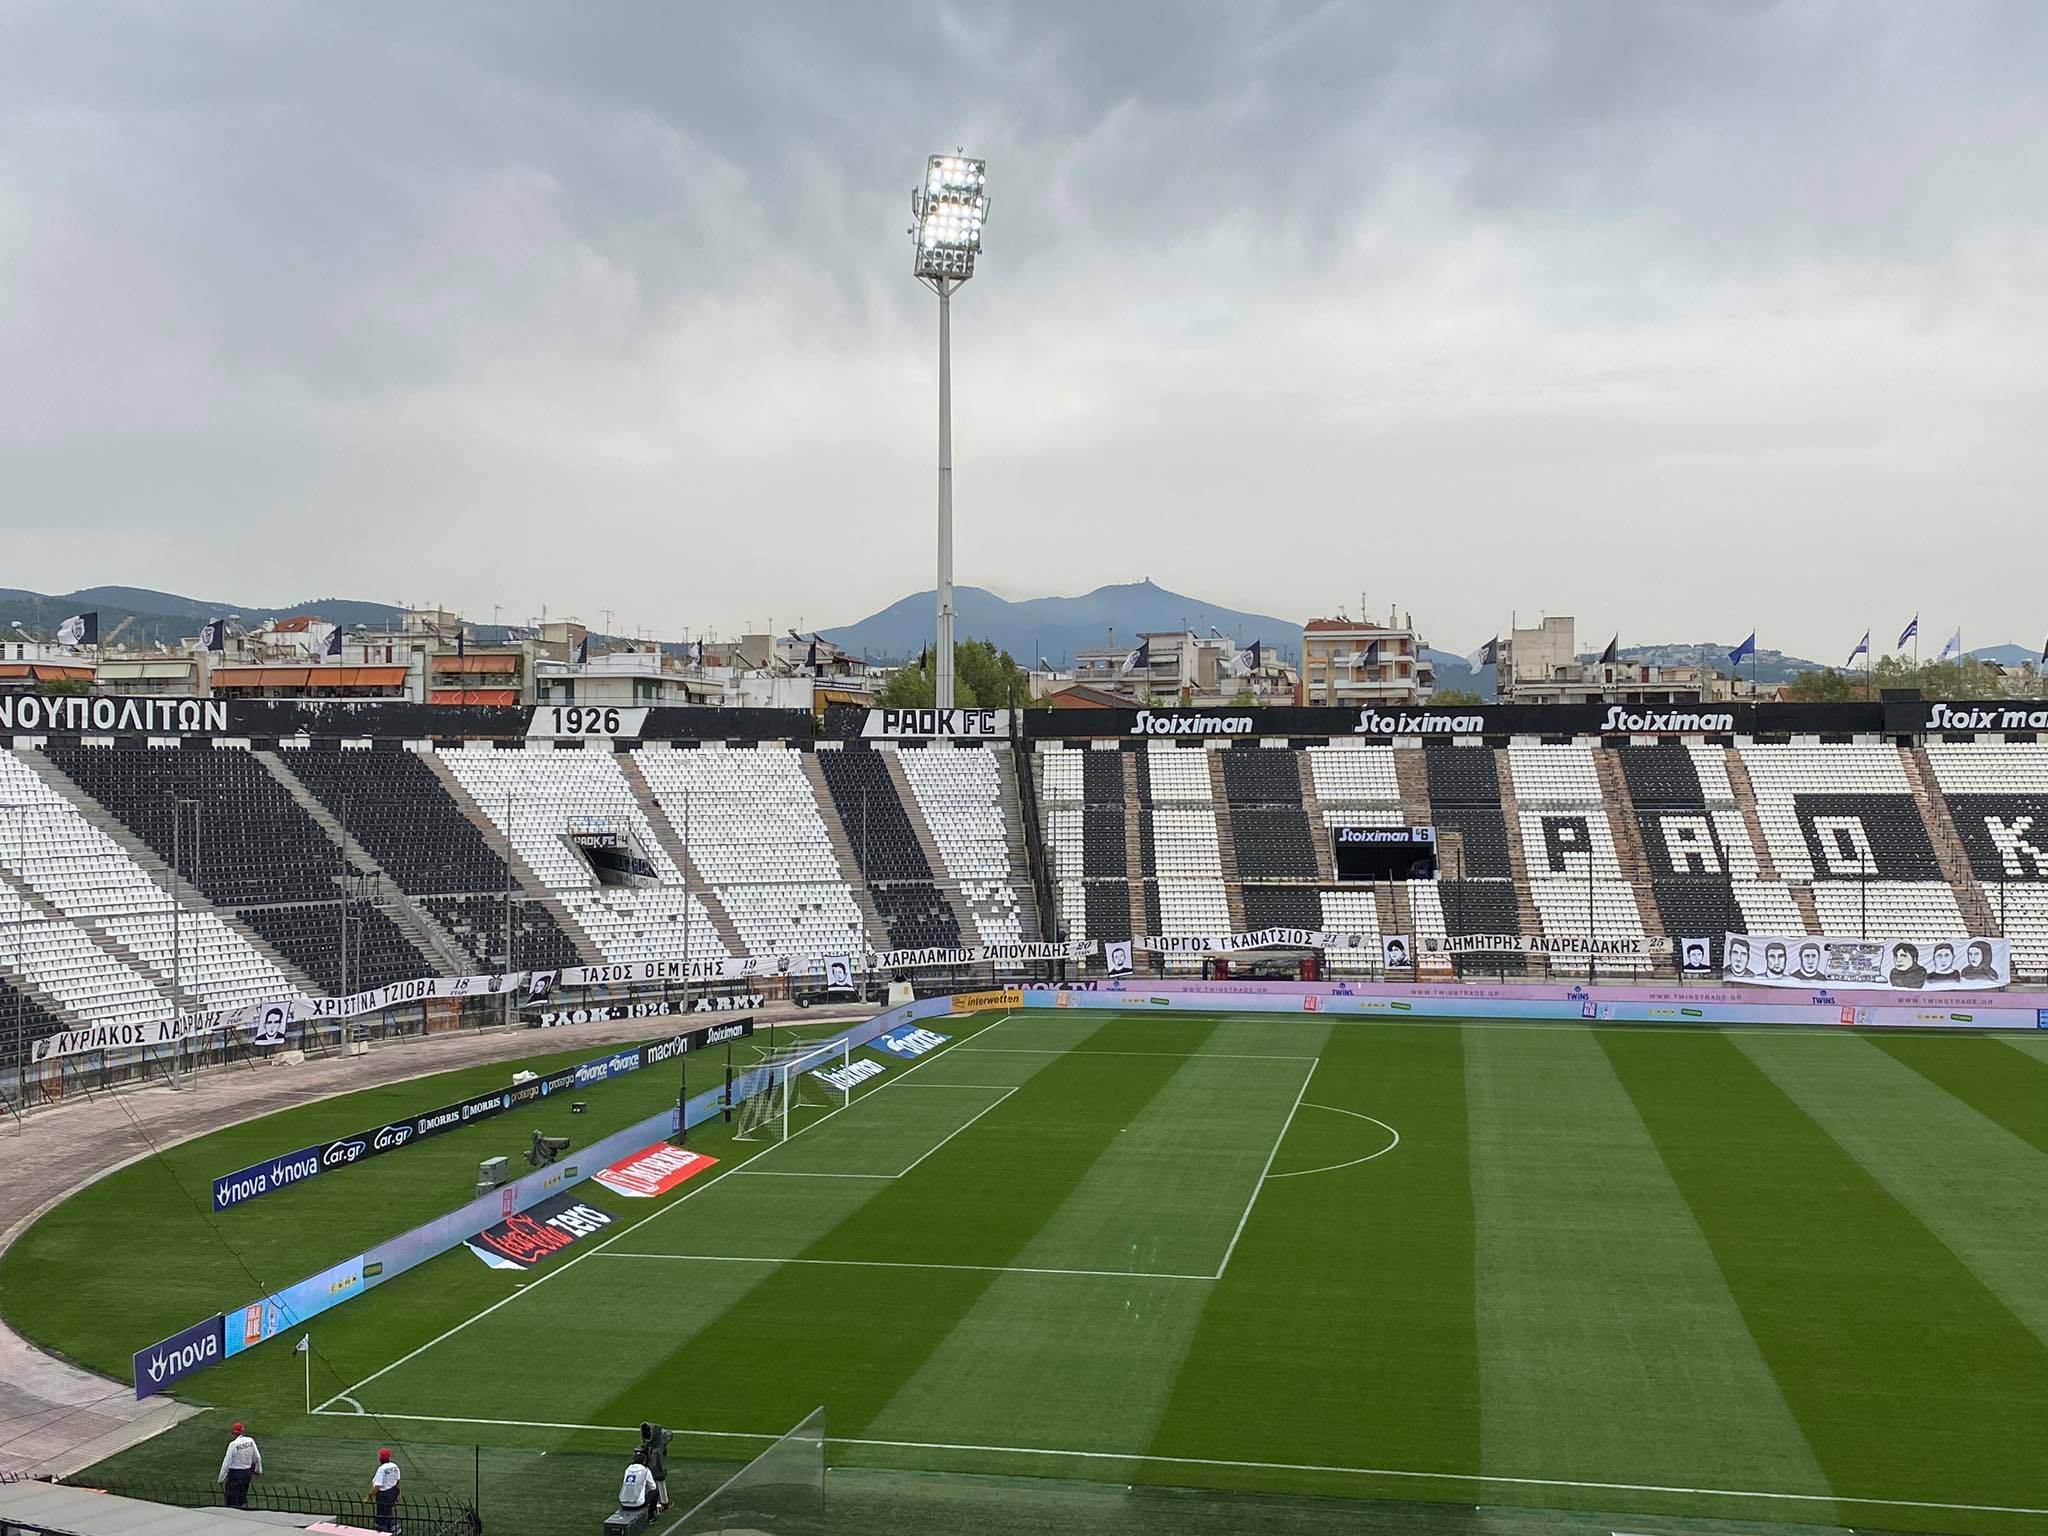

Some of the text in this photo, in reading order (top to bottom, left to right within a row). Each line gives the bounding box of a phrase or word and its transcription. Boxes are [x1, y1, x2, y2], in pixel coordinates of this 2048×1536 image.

[552, 708, 620, 734] 1926
[882, 708, 996, 735] PAOK FC
[1130, 710, 1253, 735] Stoiximan
[1354, 709, 1484, 734] Stoiximan
[1601, 705, 1734, 731] Stoiximan
[1339, 827, 1409, 842] Stoiximan
[1220, 929, 1313, 949] ΓΚΑΝΑΤΣΙΟΣ
[1443, 936, 1640, 953] ΔΗΜΗΤΡΗΣ ΑΝΔΡΕΑΔΑΚΗΣ
[883, 943, 1070, 968] ΧΑΡΑΛΑΜΠΟΣ ΖΑΠΟΥΝΙΔΗΣ
[454, 978, 470, 989] 18
[581, 960, 724, 983] ΤΑΣΟΣ ΘΕΜΕΛΗΣ
[312, 979, 436, 1016] ΧΡΙΣΤΙΝΑ ΤΖΙΟΒΑ
[627, 1002, 670, 1018] 1926
[967, 993, 1019, 1007] interwetten
[1812, 997, 1835, 1005] TWINS
[58, 1025, 145, 1052] ΚΥΡΙΑΚΟΣ
[706, 1025, 743, 1044] Stoiximan
[648, 1036, 688, 1064] macron
[470, 1097, 501, 1116] MORRIS
[426, 1111, 459, 1130] MORRIS
[285, 1157, 318, 1184] nova
[231, 1173, 265, 1202] nova
[169, 1334, 217, 1375] nova
